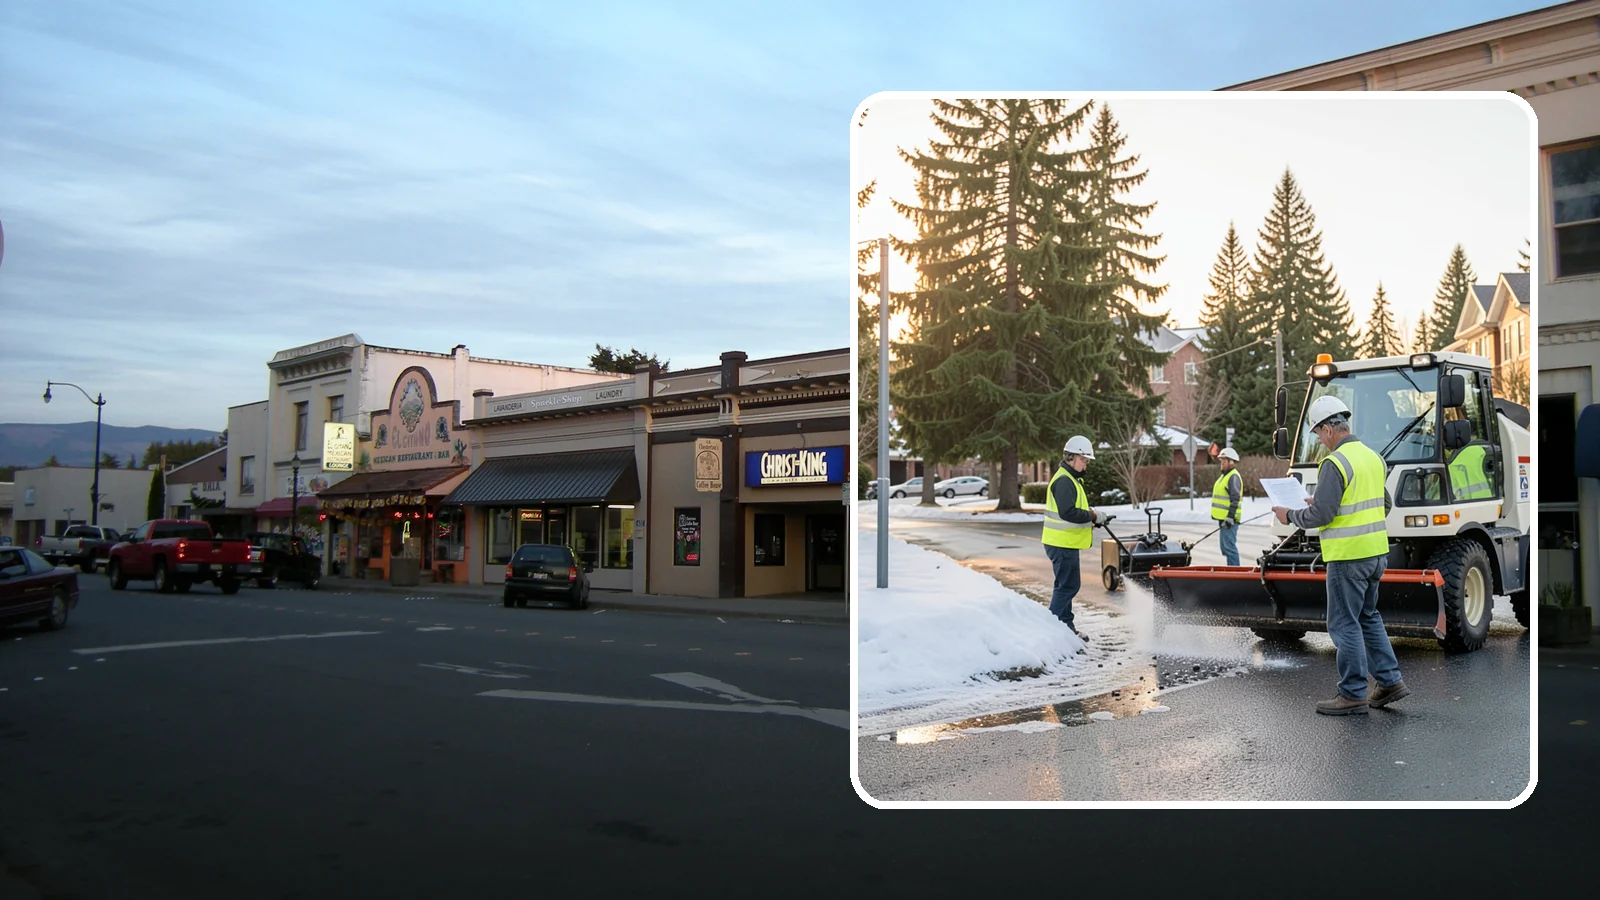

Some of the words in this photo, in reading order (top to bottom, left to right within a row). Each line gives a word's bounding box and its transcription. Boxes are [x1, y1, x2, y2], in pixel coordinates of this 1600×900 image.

[494, 402, 522, 412] LAVANDERIA
[531, 397, 560, 408] Sparkle
[562, 395, 581, 404] Shop
[595, 389, 623, 399] LAUNDRY
[373, 454, 396, 464] MEXICAN
[397, 451, 433, 462] RESTAURANT
[438, 450, 449, 459] BAR
[761, 452, 797, 478] CHRIST
[799, 450, 827, 476] KING
